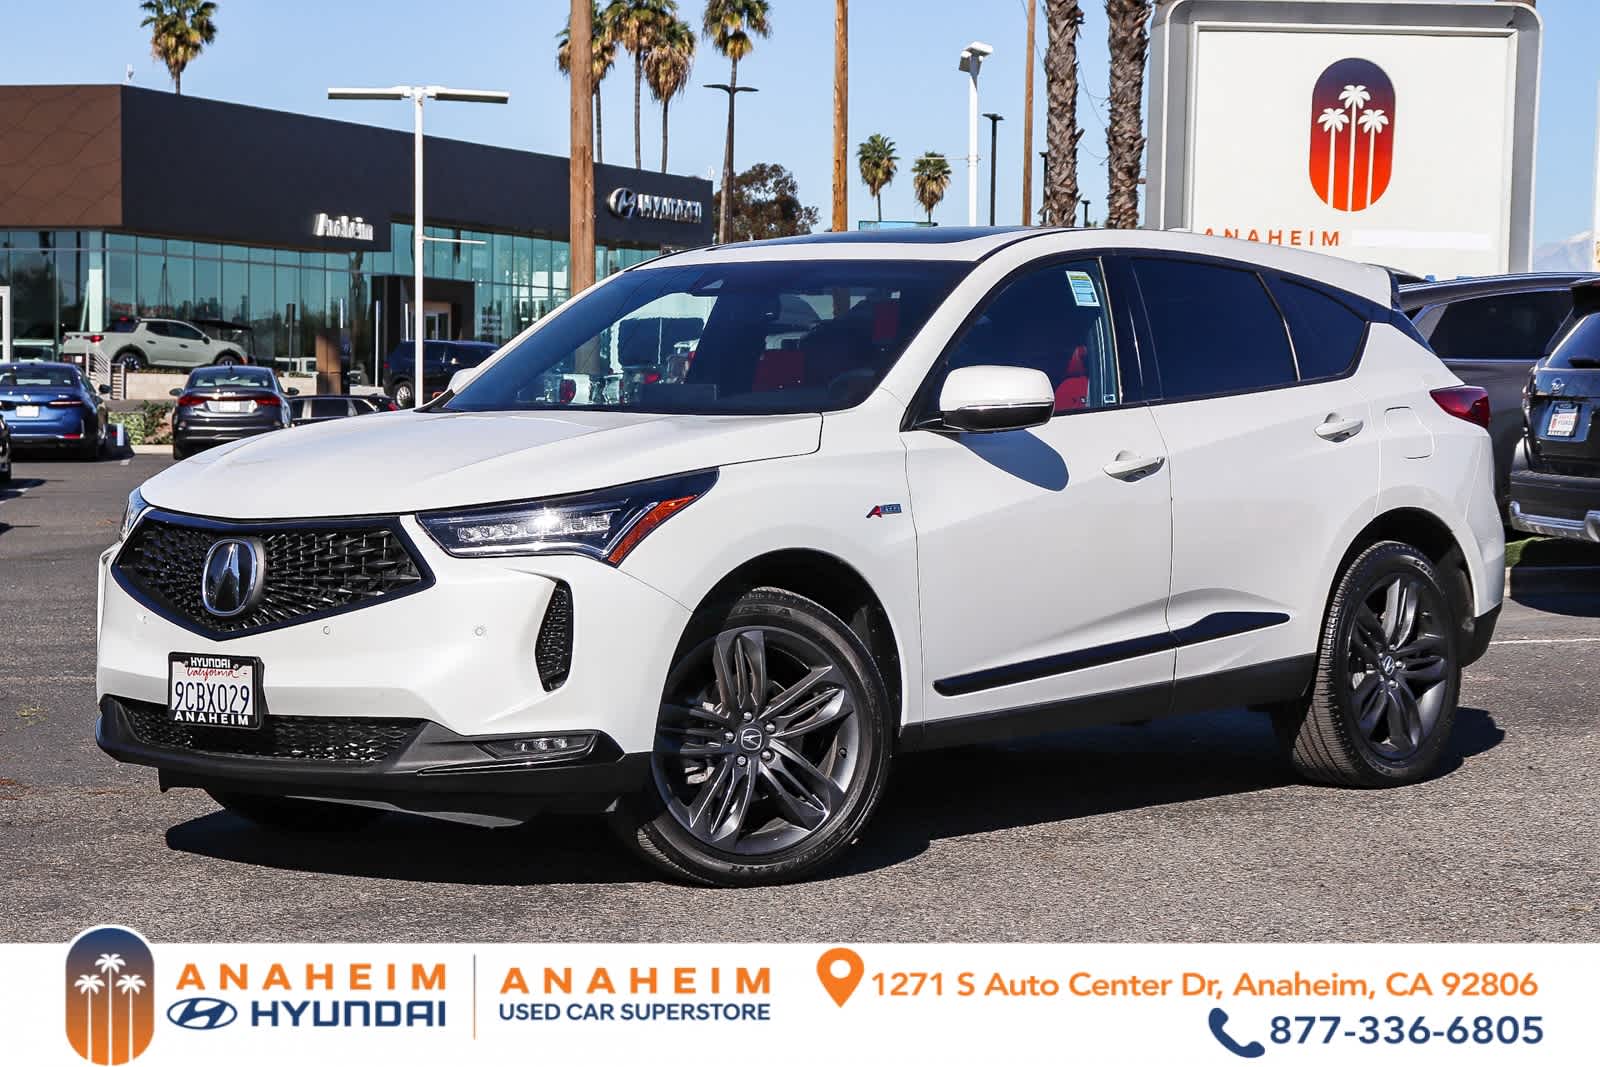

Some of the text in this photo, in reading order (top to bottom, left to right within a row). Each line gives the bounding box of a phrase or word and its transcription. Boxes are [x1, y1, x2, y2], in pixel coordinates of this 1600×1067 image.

[190, 657, 231, 668] HYUNDAI
[174, 681, 250, 714] 9CBX029
[174, 711, 249, 726] ANAHEIM
